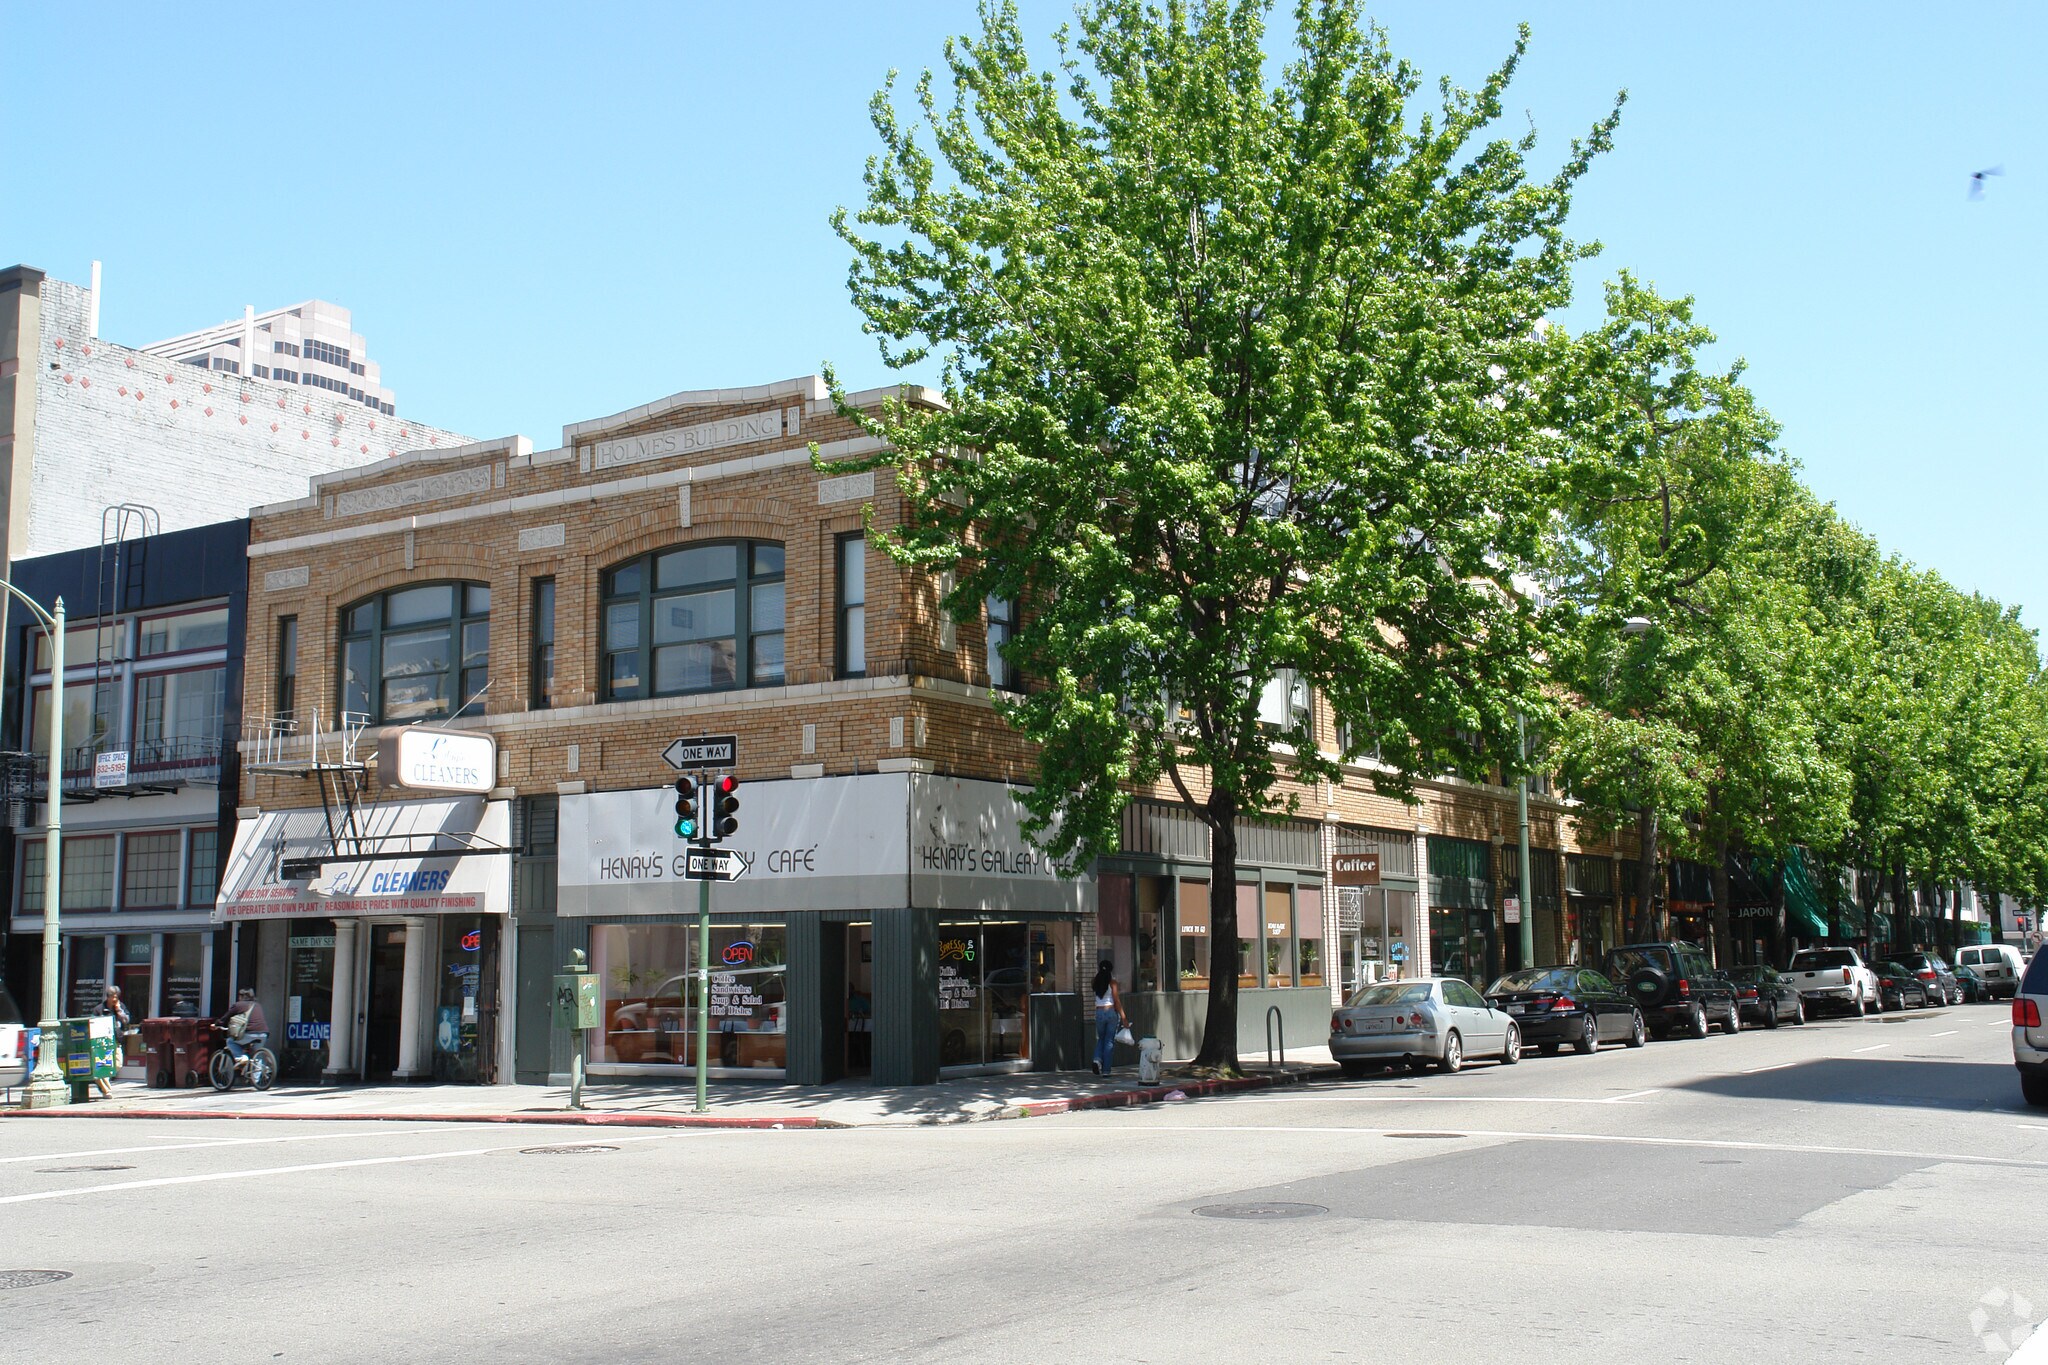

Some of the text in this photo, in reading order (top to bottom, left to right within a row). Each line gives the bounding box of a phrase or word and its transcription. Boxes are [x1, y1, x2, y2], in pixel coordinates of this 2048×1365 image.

[600, 435, 676, 464] HOLMES
[682, 746, 728, 760] ONE WAY
[414, 764, 479, 785] CLEANERS
[600, 851, 663, 880] HENRY'S
[691, 858, 708, 870] ONE
[711, 859, 730, 872] WAY
[923, 845, 977, 871] HENRY'S
[981, 849, 1040, 875] GALLERY
[1335, 858, 1376, 872] Coffee
[372, 869, 450, 893] CLEANERS
[226, 905, 237, 916] WE
[237, 904, 266, 916] OPERATE
[266, 903, 281, 914] OUR
[281, 902, 297, 913] OWN
[298, 902, 319, 912] PLANT
[325, 900, 368, 911] REASONABLE
[369, 899, 390, 910] PRICE
[391, 898, 409, 909] WITH
[411, 898, 440, 909] QUALITY
[440, 896, 476, 908] FINISHING
[1738, 907, 1774, 918] JAPON
[130, 943, 151, 954] 1708
[291, 937, 309, 947] SAME
[310, 937, 323, 946] DAY
[722, 946, 753, 960] OPEN
[711, 974, 736, 983] Coffee
[711, 984, 752, 994] Sandwiches
[711, 995, 762, 1006] Soup & Salad
[711, 1006, 753, 1015] Hot Dishes
